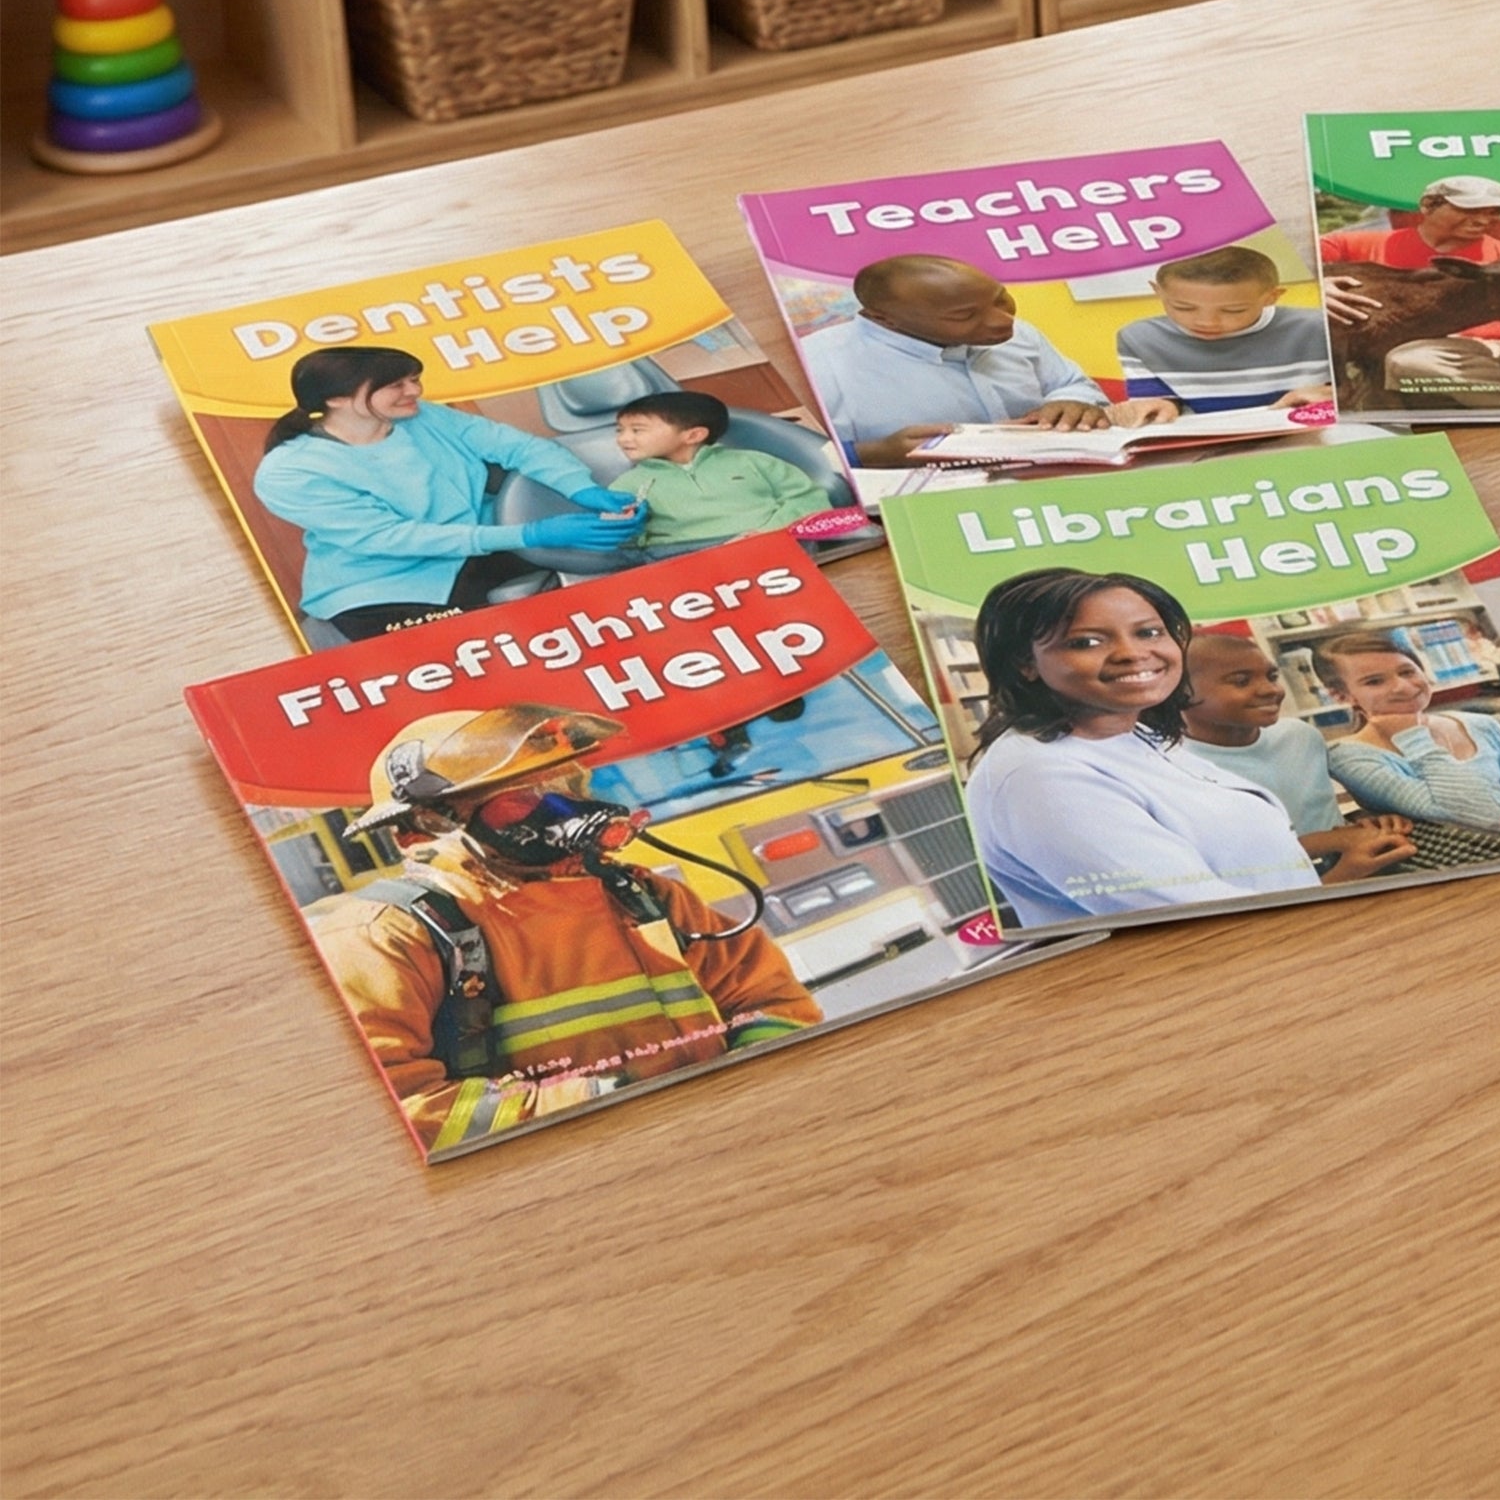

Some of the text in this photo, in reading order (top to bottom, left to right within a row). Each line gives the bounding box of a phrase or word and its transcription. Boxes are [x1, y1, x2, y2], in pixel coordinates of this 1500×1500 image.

[808, 168, 1222, 236] Teachers
[985, 210, 1182, 261] Help
[233, 253, 651, 360] Dentists
[433, 305, 649, 370] Help
[956, 468, 1451, 554] Librarians
[1184, 521, 1417, 585] Help
[277, 567, 802, 728] Firefighters
[583, 622, 825, 711] Help
